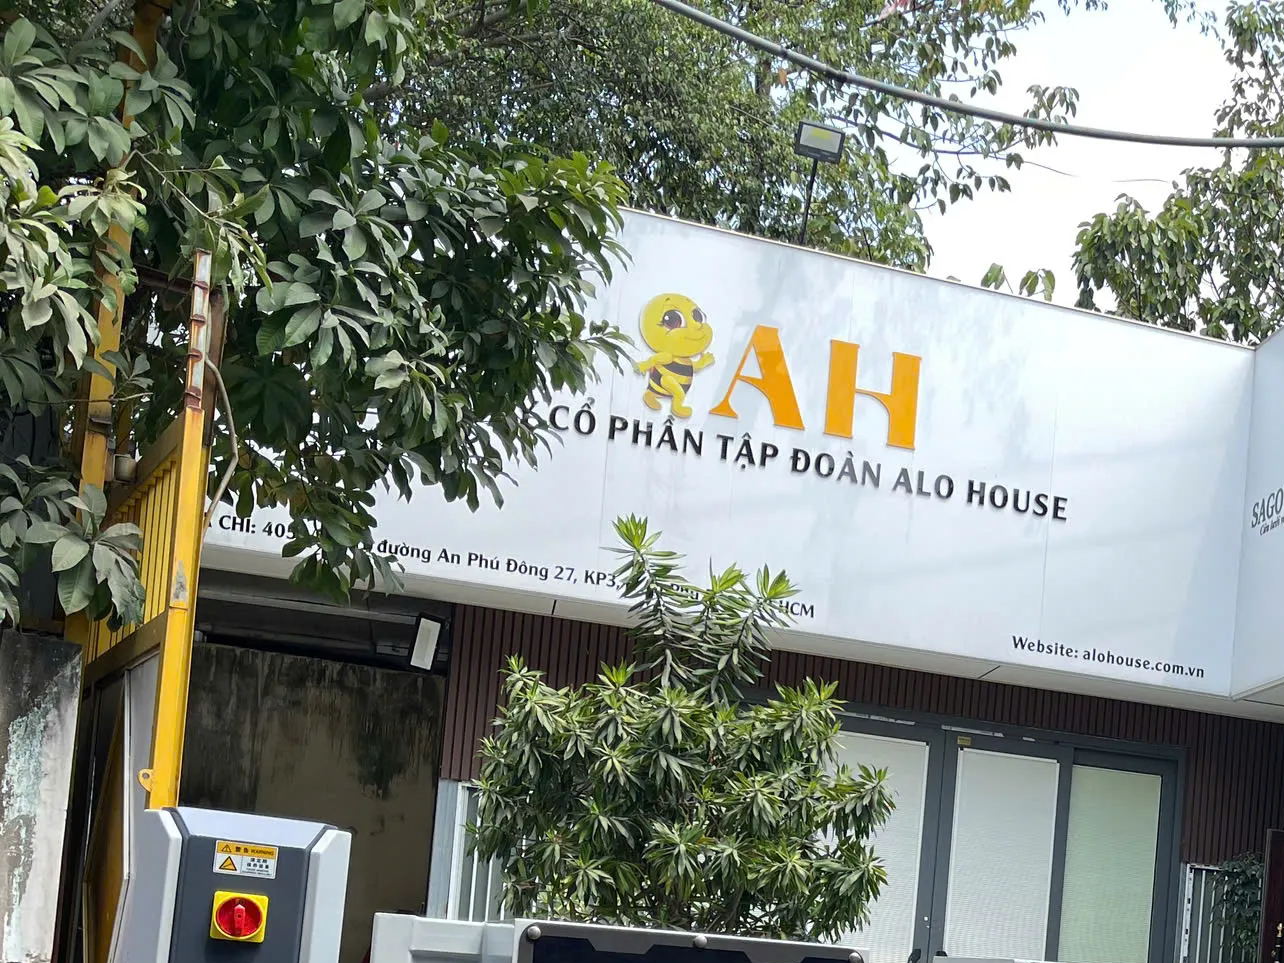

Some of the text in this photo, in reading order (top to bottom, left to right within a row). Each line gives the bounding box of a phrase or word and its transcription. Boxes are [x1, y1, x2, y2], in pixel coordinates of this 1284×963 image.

[708, 324, 921, 450] AH
[549, 397, 1068, 521] CỔ PHẦN TẬP ĐOÀN ALO HOUSE
[377, 539, 431, 563] đường
[437, 548, 461, 565] An
[467, 552, 500, 571] Phú
[506, 558, 549, 581] Đông
[554, 565, 577, 584] 27,
[1012, 635, 1205, 678] Website: alohouse.com.vn
